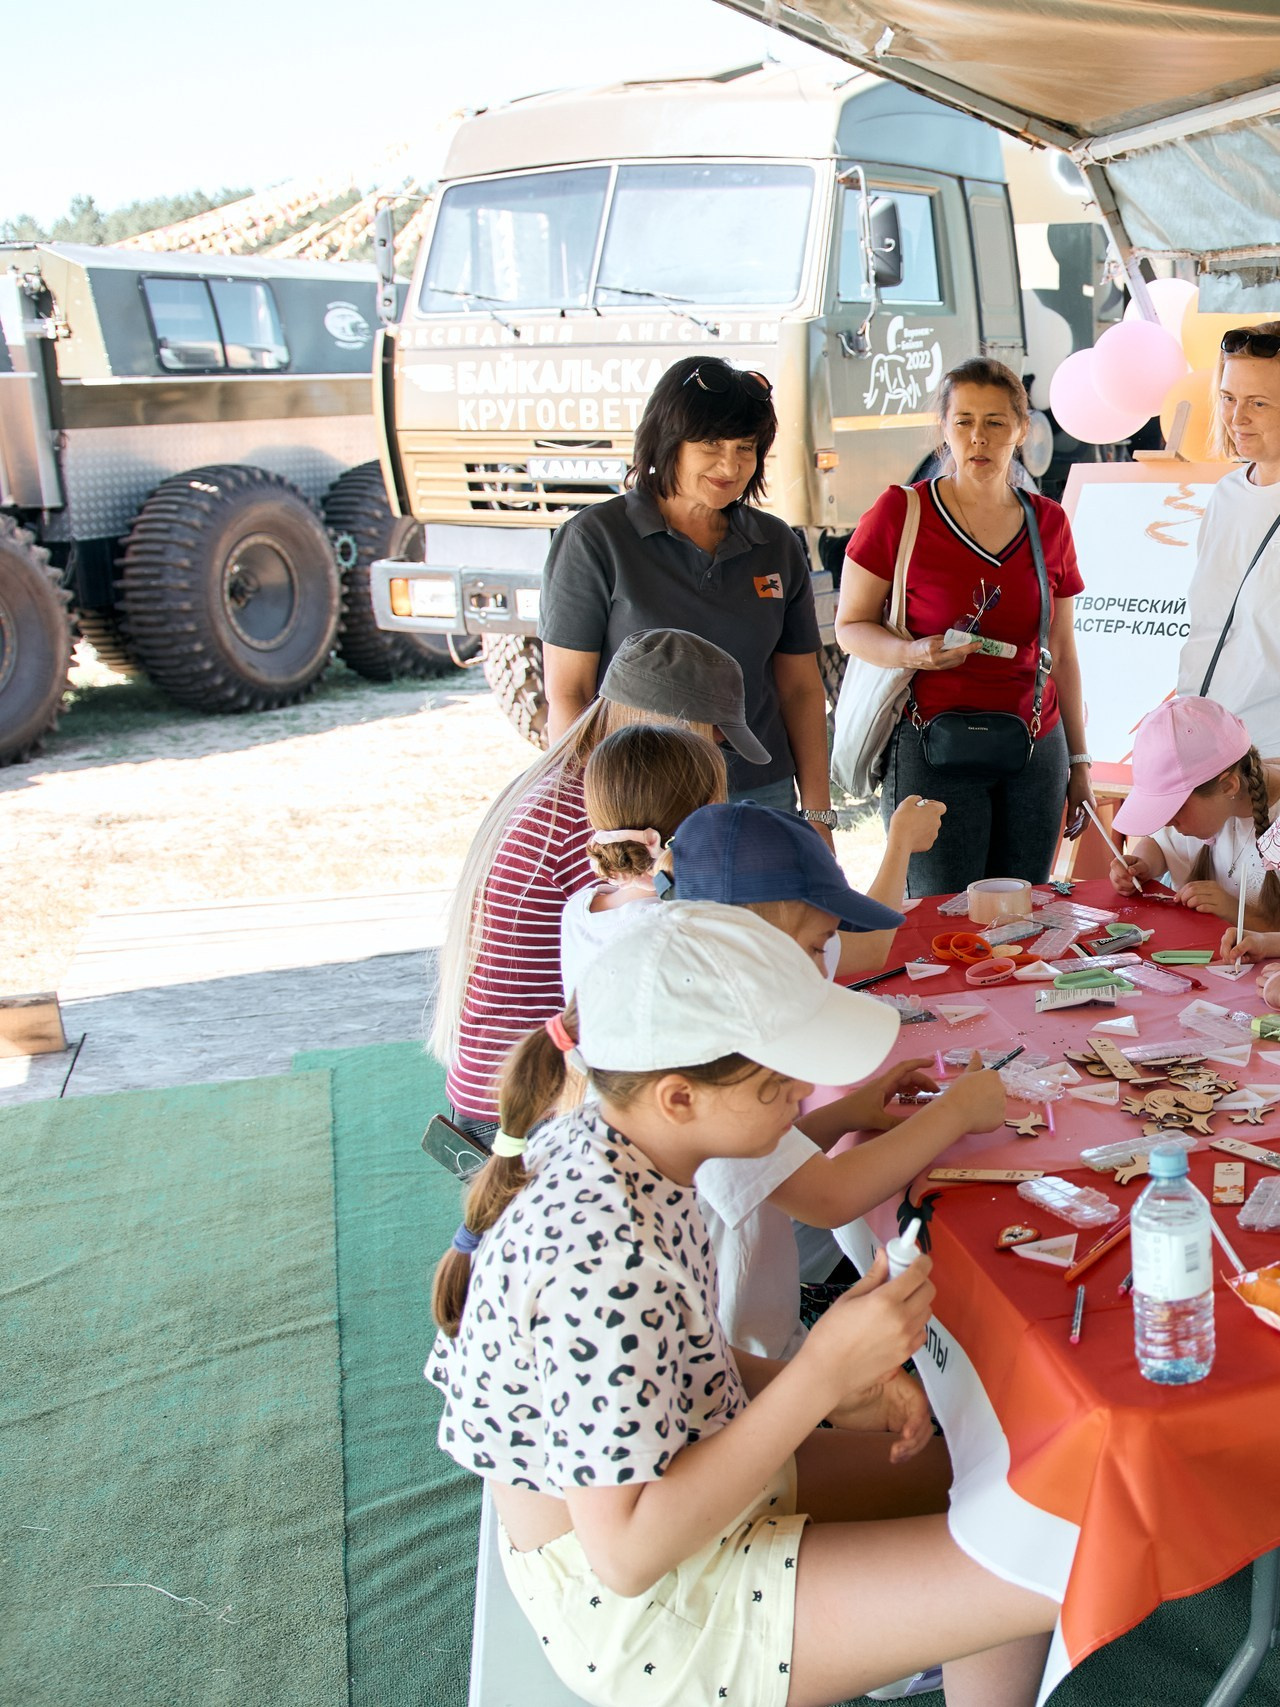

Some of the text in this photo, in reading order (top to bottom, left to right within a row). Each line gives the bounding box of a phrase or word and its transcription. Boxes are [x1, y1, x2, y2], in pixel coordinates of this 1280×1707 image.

[906, 350, 931, 370] 2022
[457, 352, 676, 395] БАЙКАЛЬСКА
[457, 398, 648, 431] КРУГОСВЕТ
[529, 459, 623, 479] KAMAZ
[1074, 596, 1187, 615] ТВОРЧЕСКИЙ
[1074, 618, 1191, 637] АСТЕР-КЛАСС
[924, 1323, 949, 1374] пы
